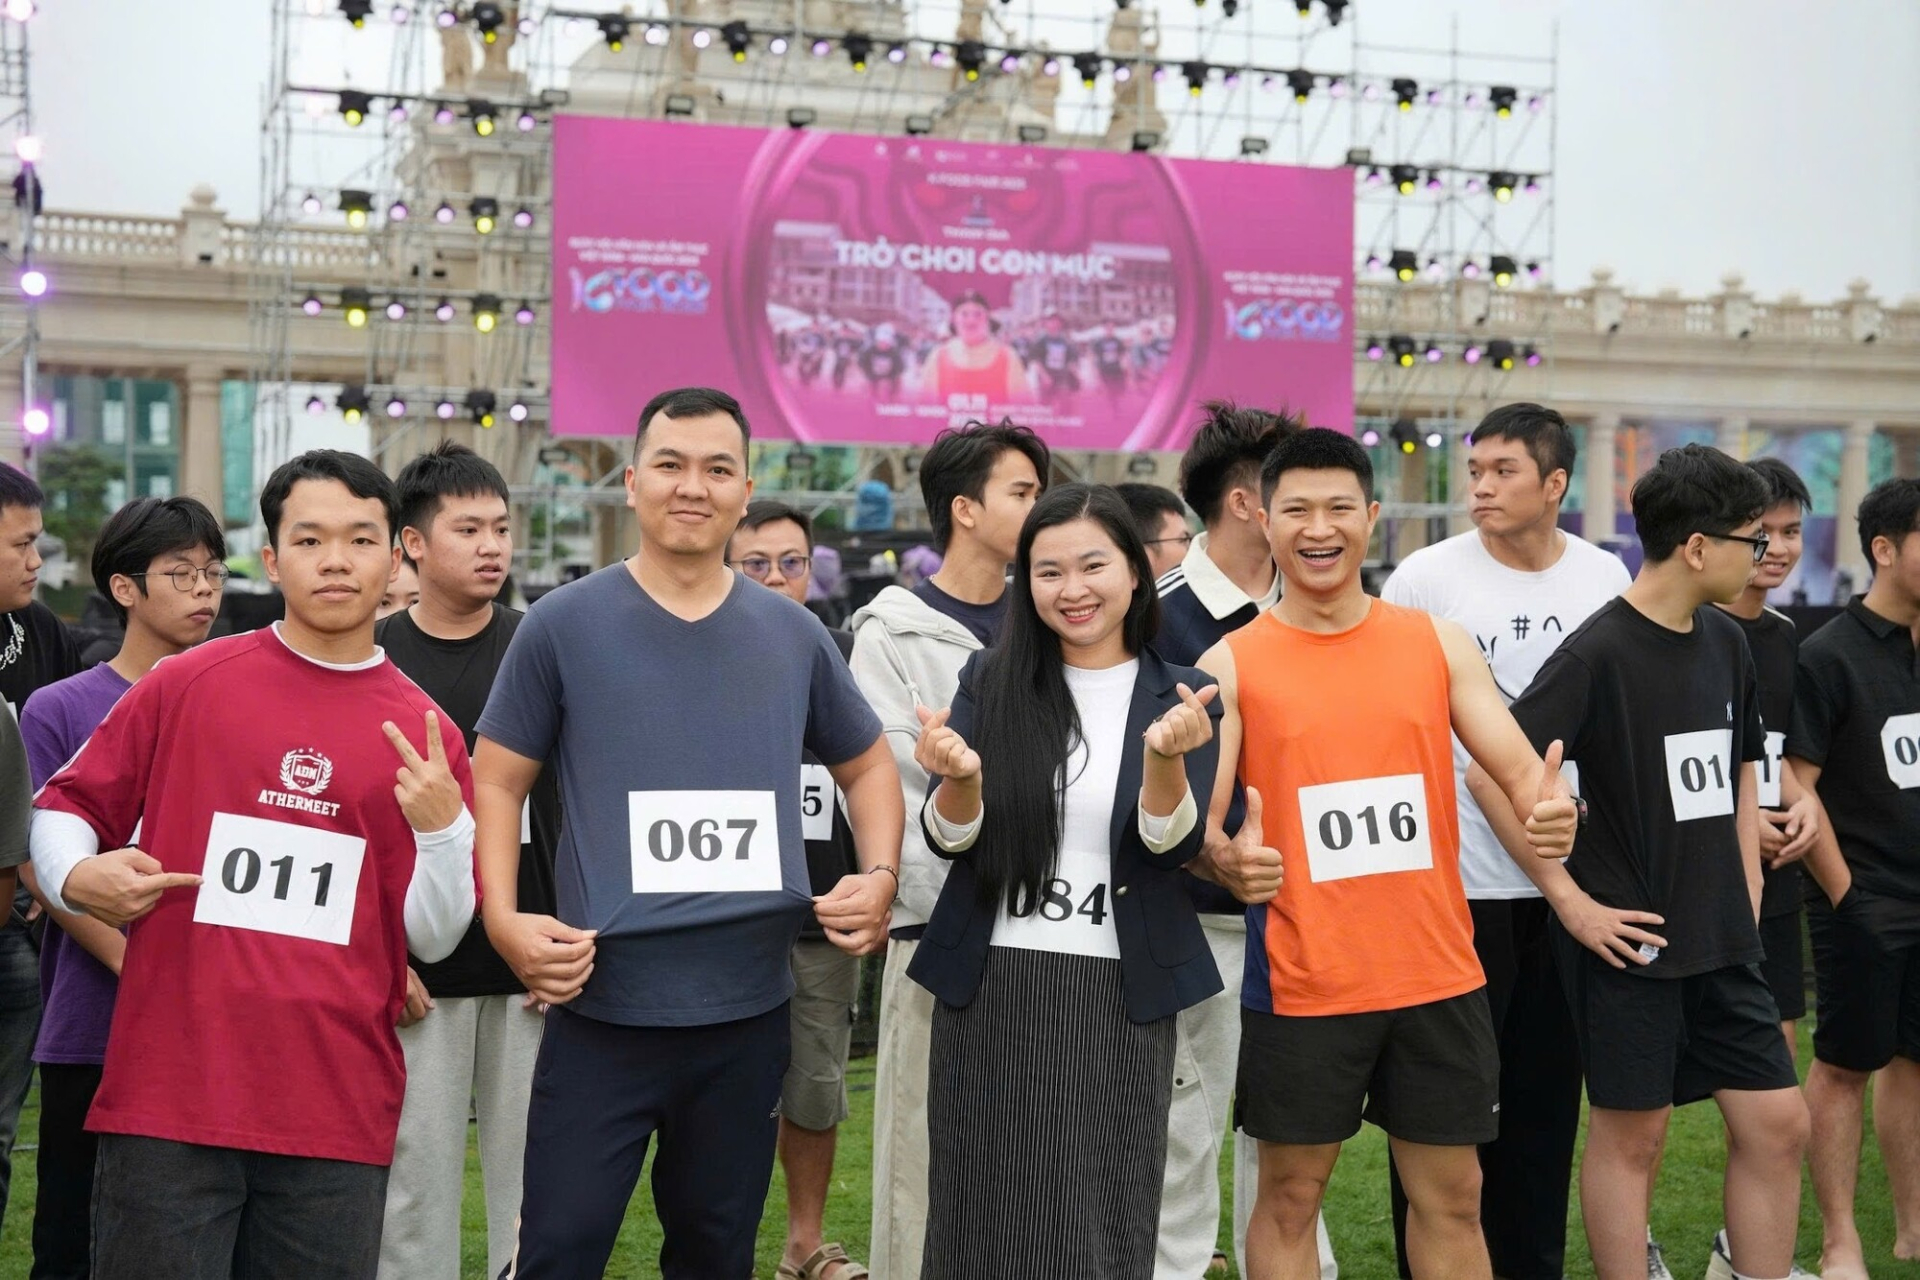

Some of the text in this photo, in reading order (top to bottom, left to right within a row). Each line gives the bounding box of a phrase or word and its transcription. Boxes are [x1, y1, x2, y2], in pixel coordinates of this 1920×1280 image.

[834, 235, 897, 268] TRÒ
[979, 247, 1046, 276] CON
[1895, 736, 1920, 765] 0
[1680, 754, 1731, 793] 01
[258, 789, 341, 817] ATHERMEET
[648, 818, 758, 862] 067
[1319, 801, 1417, 851] 016
[222, 847, 333, 907] 011
[1006, 878, 1107, 926] 084
